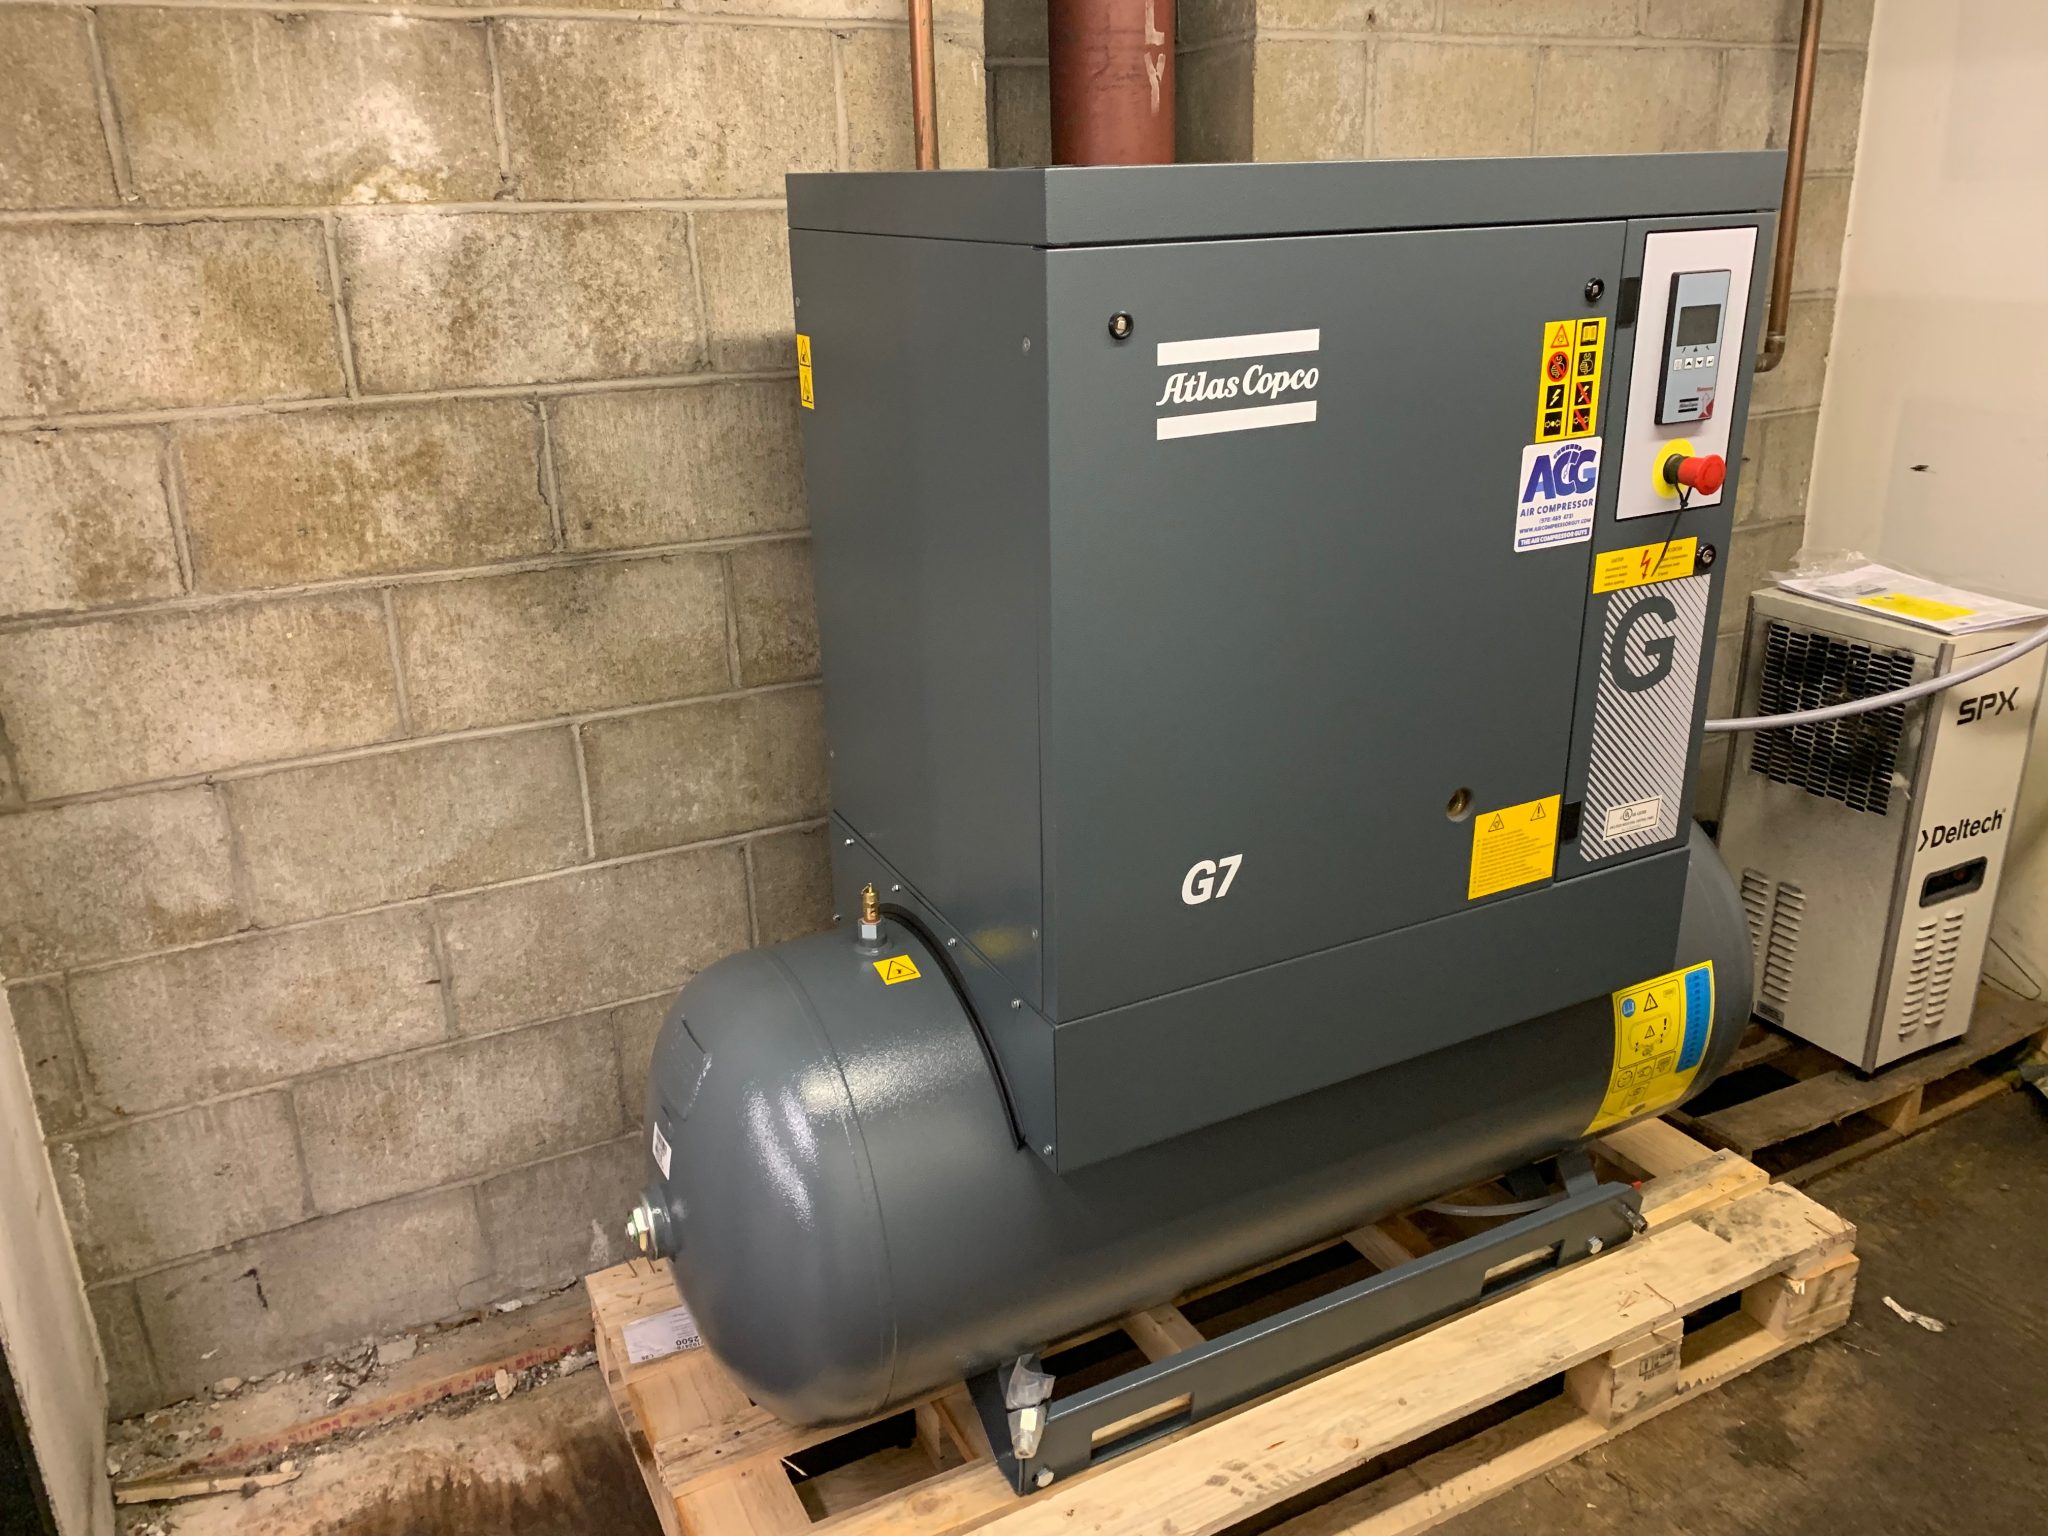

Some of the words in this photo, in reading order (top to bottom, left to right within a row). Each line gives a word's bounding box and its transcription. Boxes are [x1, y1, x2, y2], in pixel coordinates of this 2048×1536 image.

[1155, 371, 1240, 406] Atlas
[1242, 364, 1319, 399] Copco
[1522, 449, 1597, 503] ACG
[1520, 506, 1535, 518] AIR
[1536, 498, 1594, 515] COMPRESSOR
[1520, 537, 1531, 546] THE
[1610, 595, 1677, 693] G
[1956, 687, 2020, 726] SPX
[1930, 808, 2004, 849] Deltech
[1181, 853, 1243, 905] G7
[676, 1336, 700, 1346] 2500
